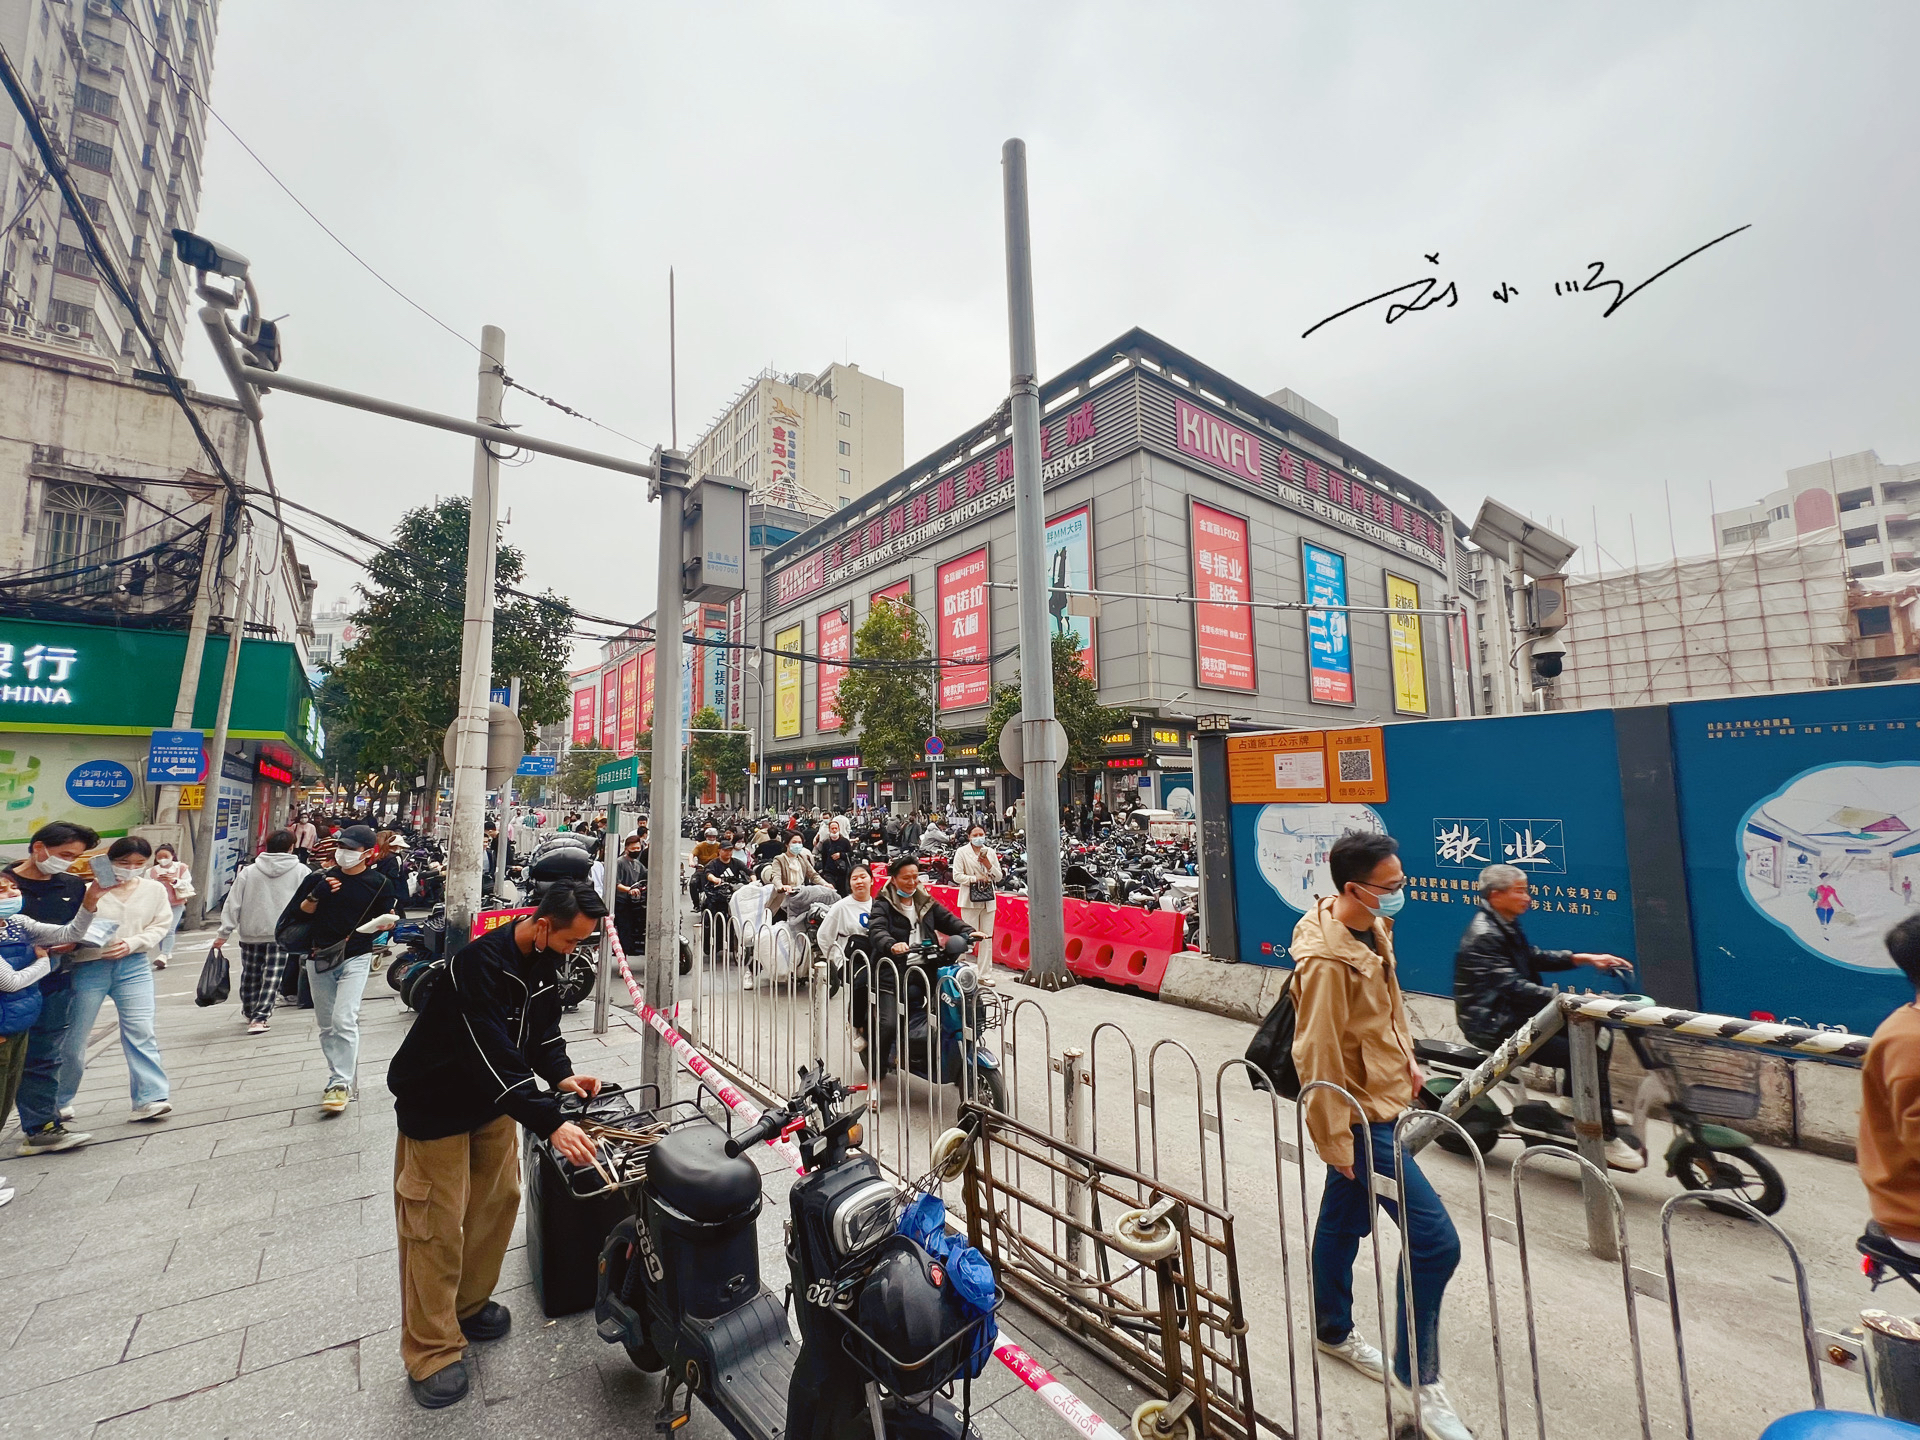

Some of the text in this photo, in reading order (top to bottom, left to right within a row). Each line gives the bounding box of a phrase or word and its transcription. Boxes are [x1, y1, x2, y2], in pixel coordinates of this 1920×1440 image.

[1182, 407, 1258, 476] KINFL
[829, 399, 1096, 569] 金富丽网络服装批城
[829, 442, 1097, 585] KINFL NETWORK CLOTHING WHOLESAL ARKET
[1277, 484, 1307, 508] KINFL
[1313, 499, 1357, 530] NETWORK
[1363, 522, 1404, 548] CLOTHING
[780, 559, 819, 601] KINFL
[1198, 549, 1243, 583] 粤振业
[943, 584, 983, 617] 欧诺拉
[1201, 656, 1227, 674] 搜款网
[0, 684, 72, 704] HINA
[1238, 735, 1310, 749] 占道施工公示牌
[1335, 734, 1371, 745] 占道施工
[79, 770, 123, 778] 沙河小学
[1338, 787, 1376, 796] 信息公示
[1435, 823, 1550, 865] 敬业
[1402, 876, 1617, 901] 业是职业道德的 为个人安身立命
[777, 1146, 797, 1165] CAUTION
[1004, 1351, 1036, 1383] SAFE
[1014, 1350, 1048, 1379] 安全
[1052, 1395, 1097, 1437] CAUTION
